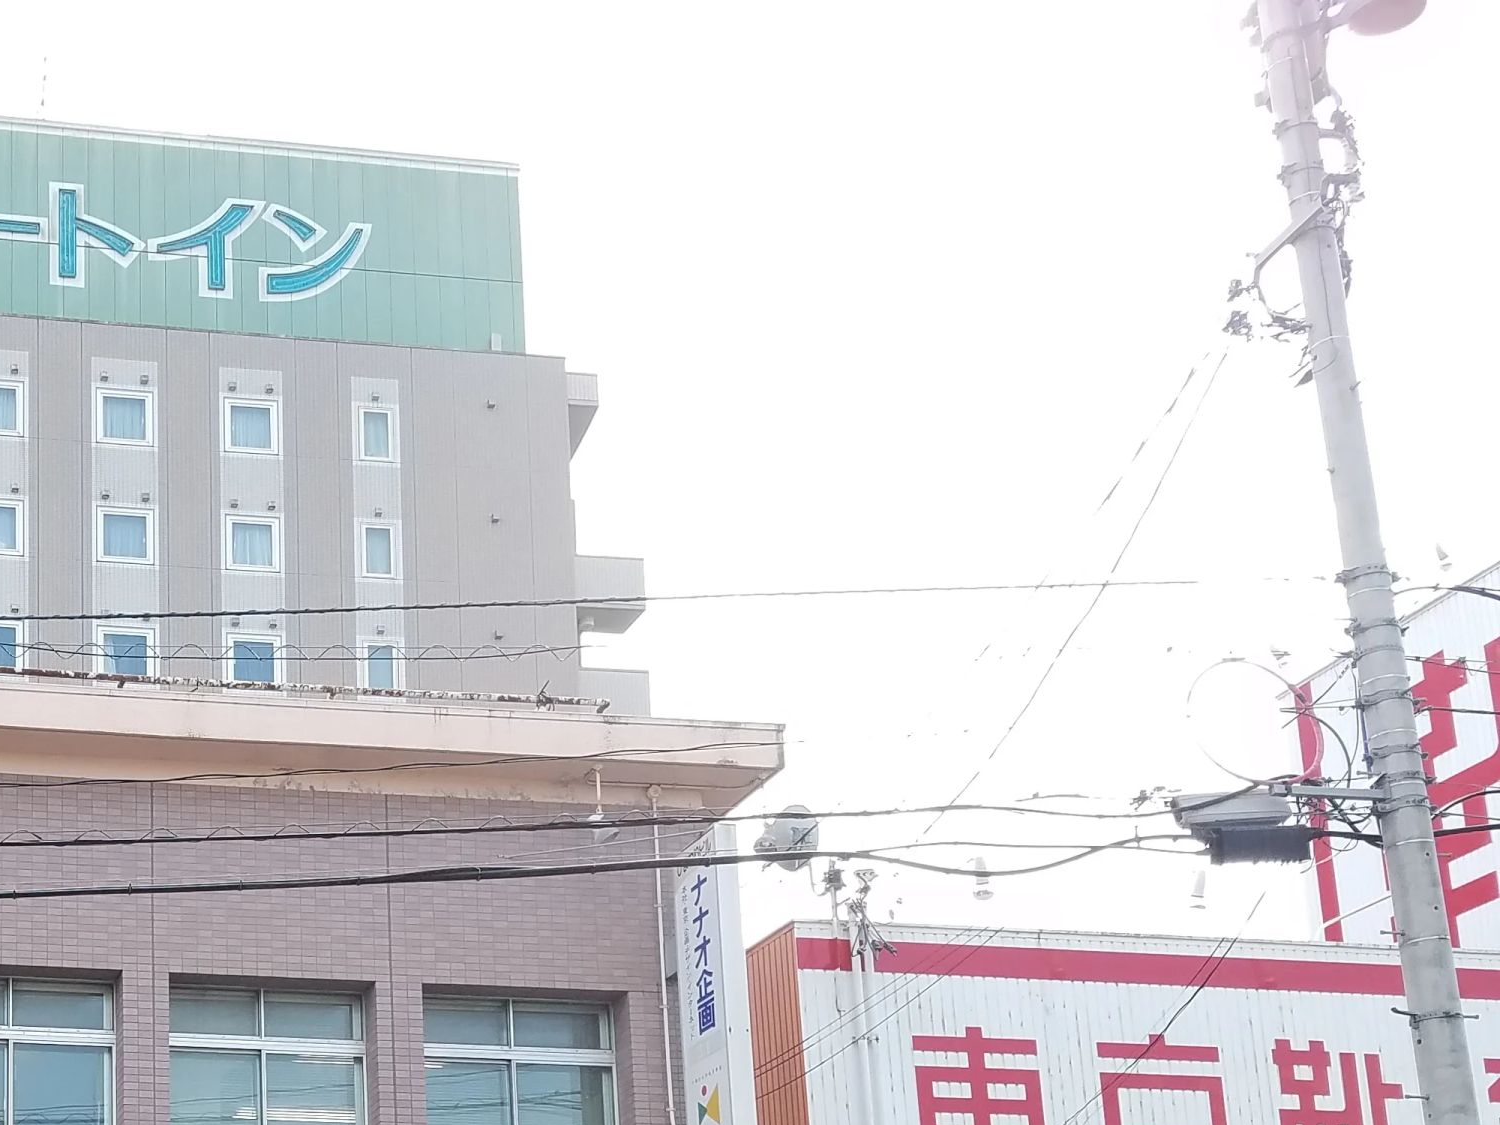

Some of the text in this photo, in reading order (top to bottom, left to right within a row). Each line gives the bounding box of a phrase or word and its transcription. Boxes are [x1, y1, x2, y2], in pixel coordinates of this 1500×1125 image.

[690, 873, 717, 1036] ナナオ企画
